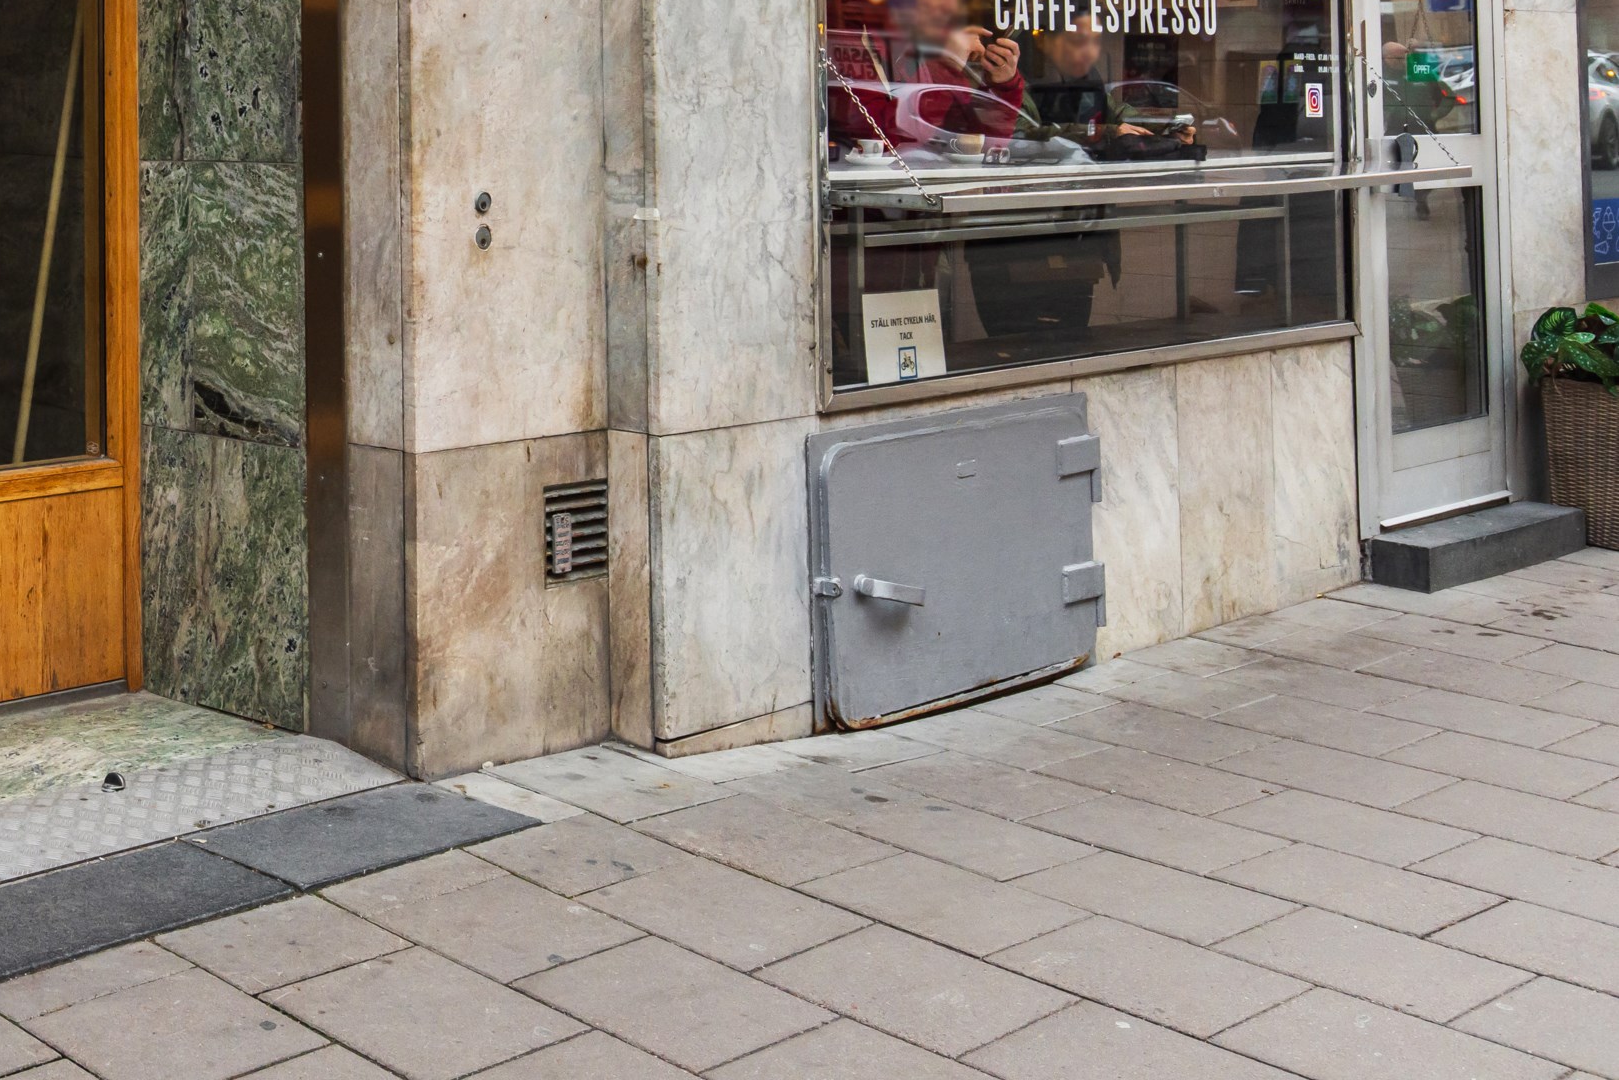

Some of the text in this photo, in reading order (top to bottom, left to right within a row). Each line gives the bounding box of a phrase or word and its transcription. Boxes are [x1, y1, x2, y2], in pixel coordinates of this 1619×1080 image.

[1413, 61, 1431, 75] ÖPPET
[870, 317, 890, 329] STÄLL
[890, 317, 903, 327] INTE
[903, 315, 923, 326] CYKELN
[899, 331, 914, 340] TACK
